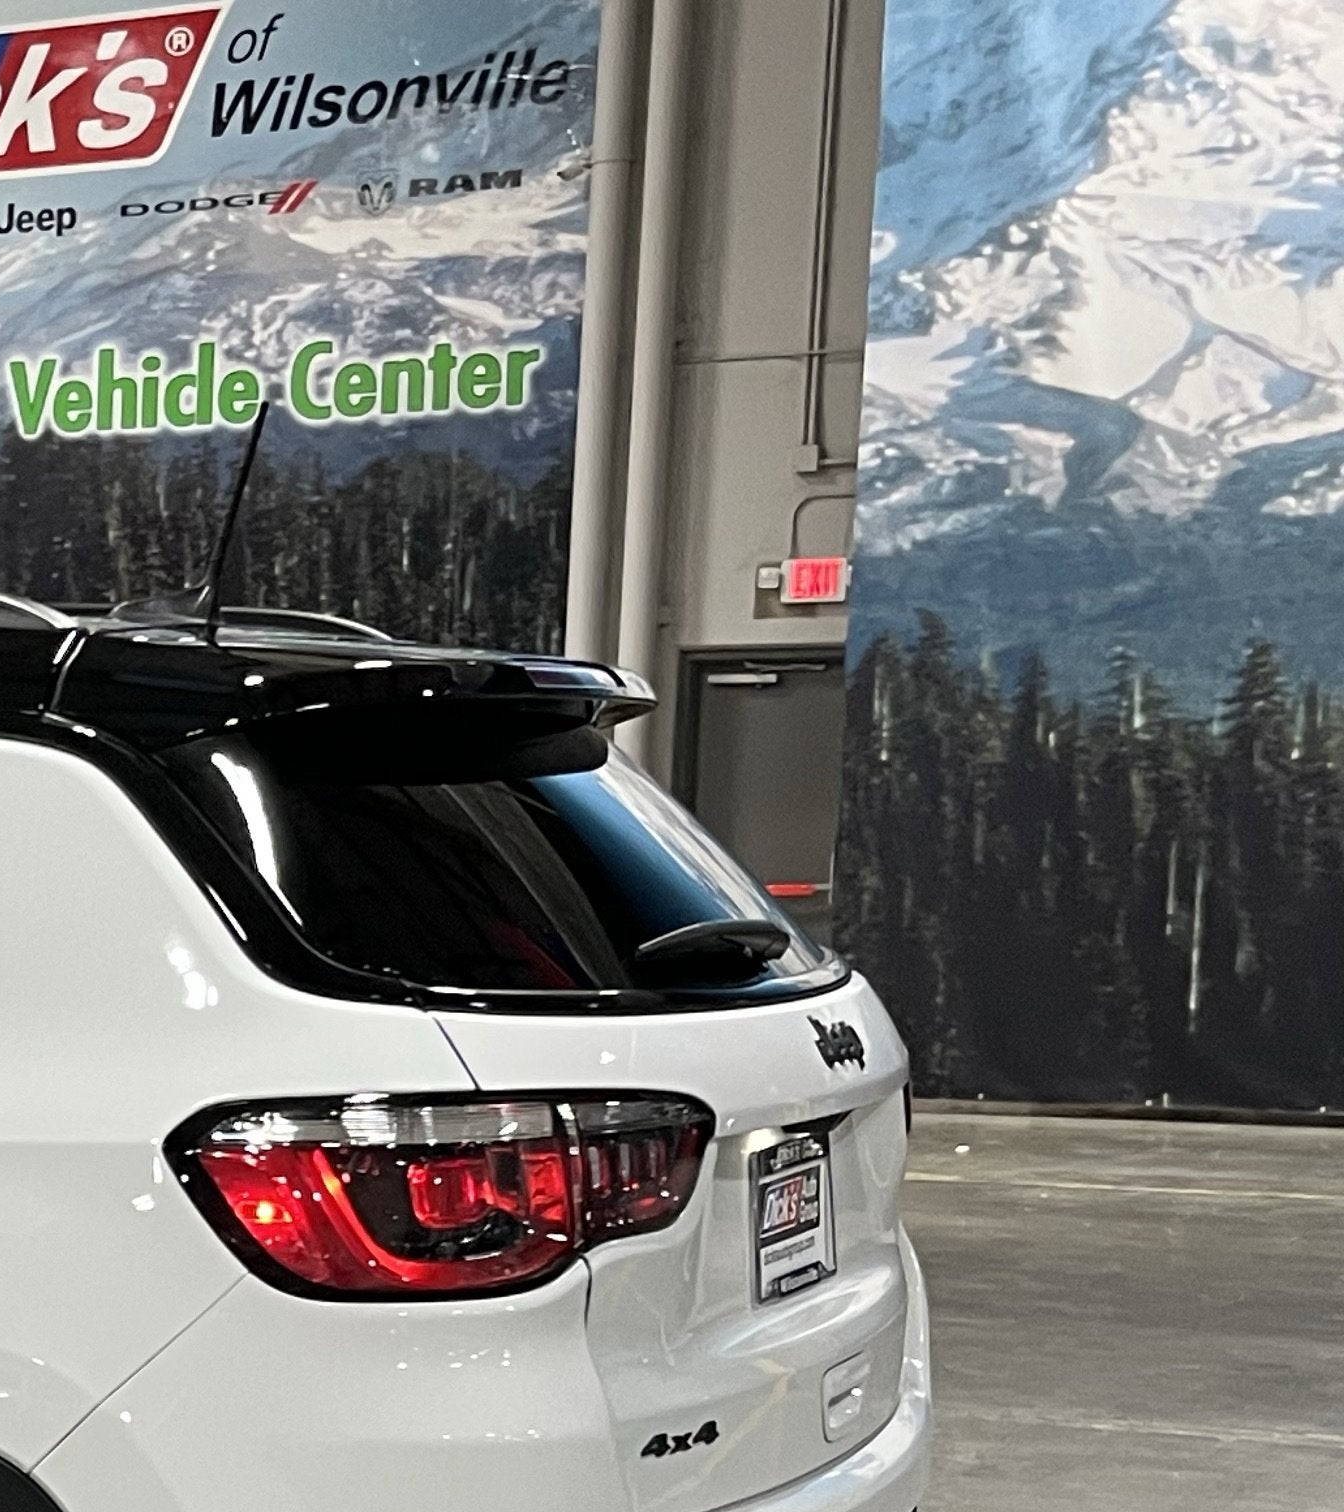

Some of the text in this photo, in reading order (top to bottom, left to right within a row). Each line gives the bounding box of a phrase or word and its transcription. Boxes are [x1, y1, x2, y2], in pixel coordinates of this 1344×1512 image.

[227, 13, 285, 64] of
[211, 48, 570, 137] Wilsonville
[408, 169, 523, 198] RAM
[119, 190, 282, 218] DODGE
[9, 342, 261, 436] Vehicle
[290, 340, 540, 421] Center
[792, 562, 841, 599] EXIT
[640, 1420, 720, 1458] 4x4
